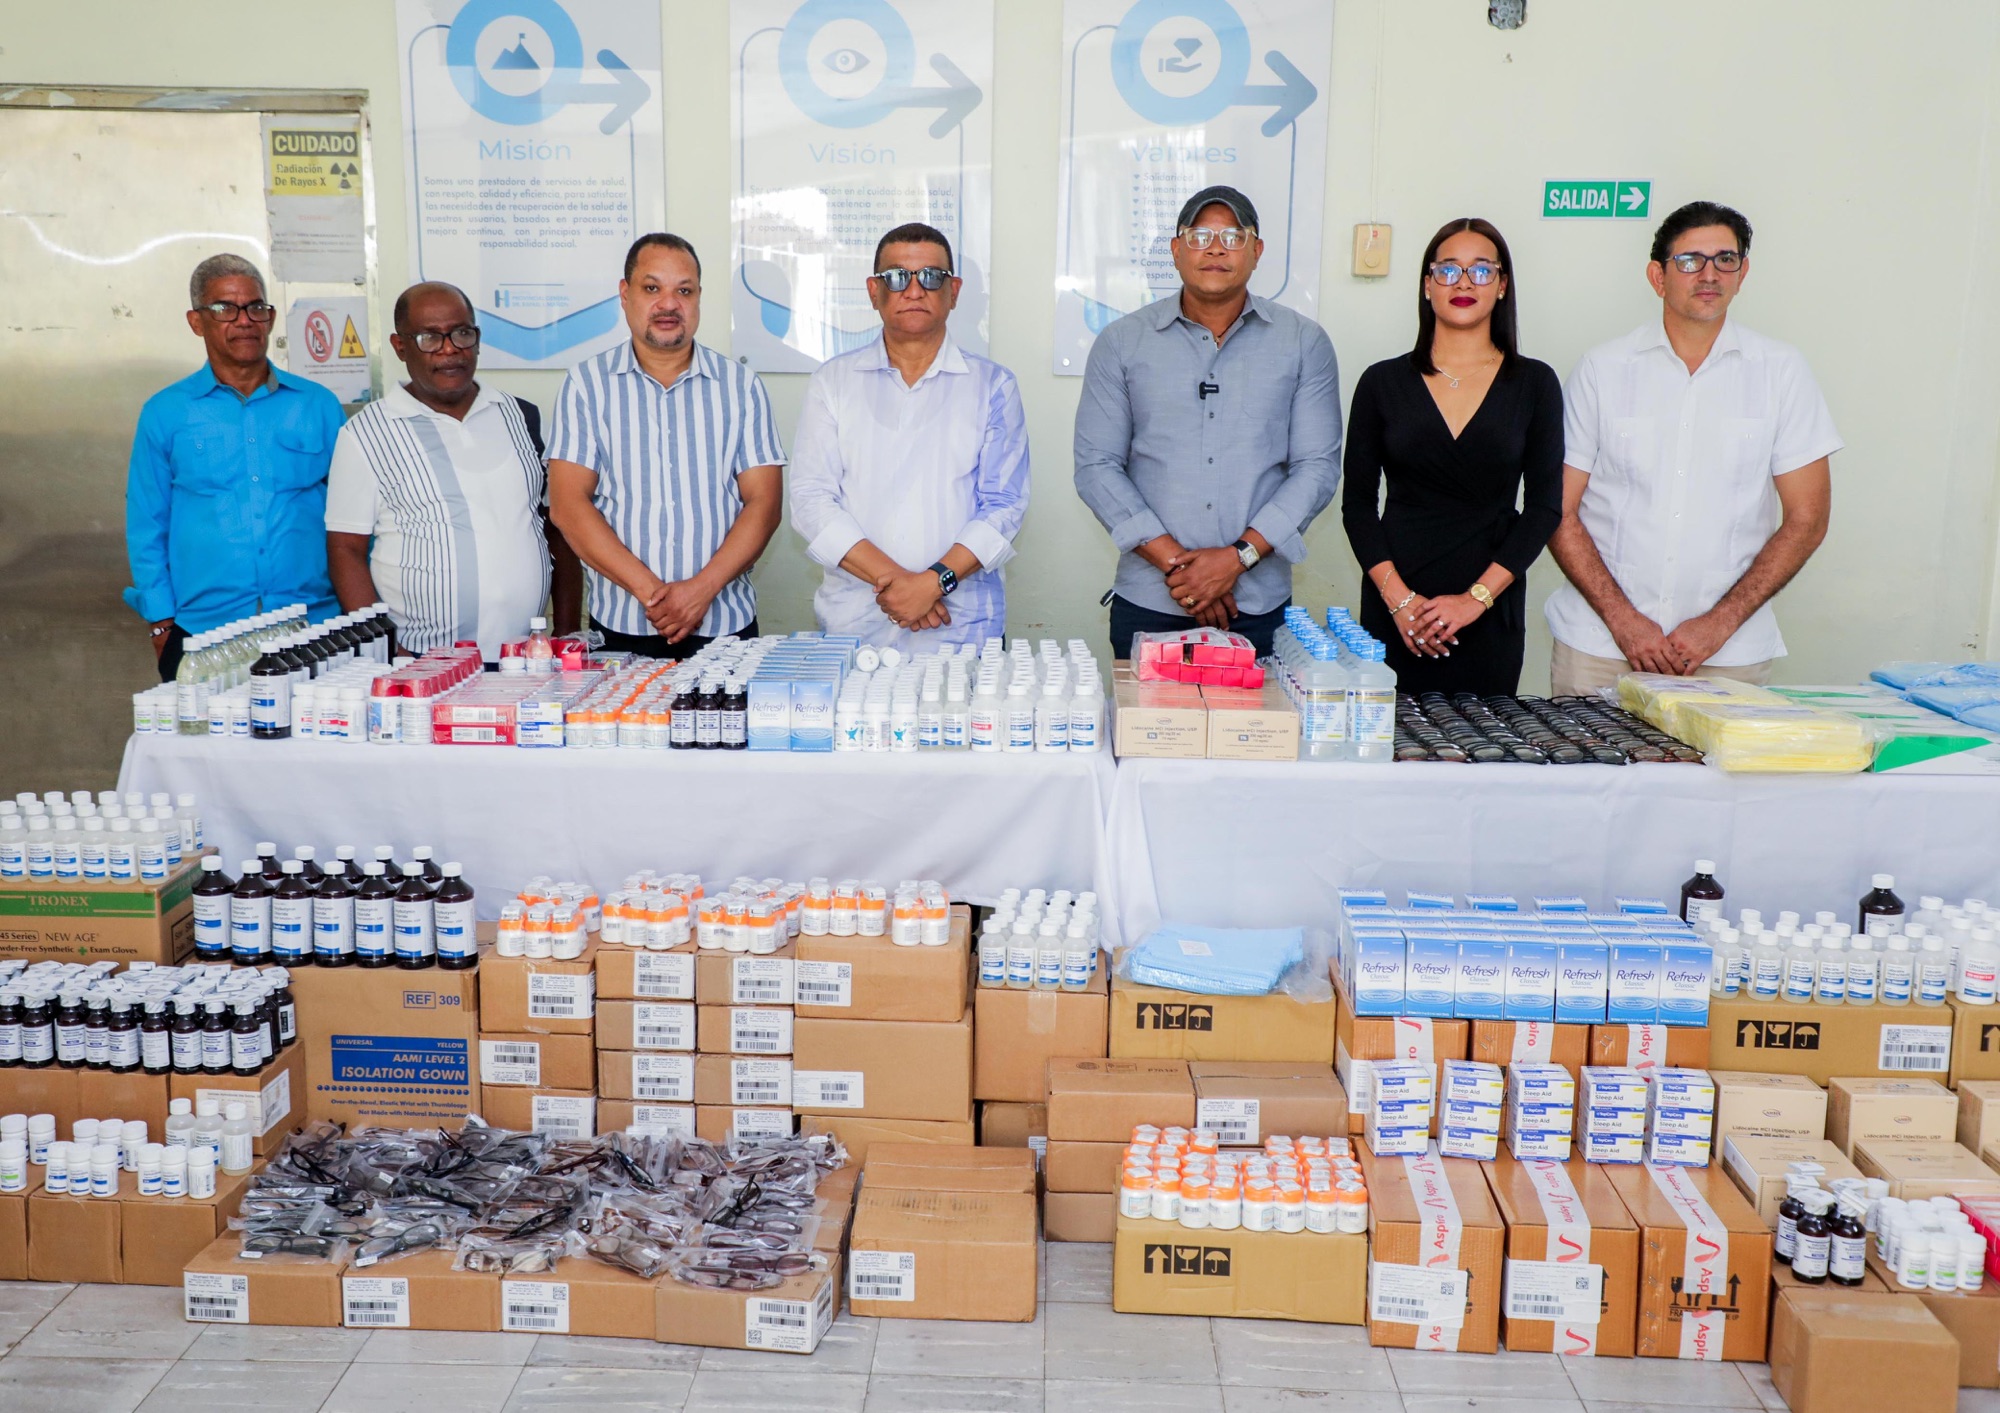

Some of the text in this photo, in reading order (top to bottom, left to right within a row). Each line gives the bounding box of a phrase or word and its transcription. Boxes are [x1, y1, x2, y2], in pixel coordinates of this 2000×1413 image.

[274, 134, 356, 154] CUIDADO
[479, 138, 571, 161] Misión
[808, 142, 896, 164] Visión
[1131, 143, 1237, 163] Valores
[277, 163, 323, 175] Radiación
[275, 176, 327, 188] De Rayos X
[424, 176, 626, 187] Somos una prestadora de servicios de salud,
[1143, 173, 1194, 182] Solidaridad
[425, 189, 627, 201] con respeto, calidad y eficiencia, para satisfacer
[845, 188, 855, 196] en
[857, 186, 865, 196] el
[867, 186, 902, 196] cuidado
[929, 187, 954, 198] salud,
[1549, 188, 1609, 211] SALIDA
[425, 202, 628, 213] las necesidades de recuperación de la salud de
[426, 215, 463, 224] nuestros
[468, 215, 507, 225] usuarios,
[513, 215, 550, 224] basados
[573, 216, 611, 226] procesos
[617, 215, 628, 224] de
[860, 212, 896, 223] integral,
[427, 227, 629, 239] mejora continua, con principios éticos y
[868, 227, 878, 235] en
[479, 240, 577, 251] responsabilidad social.
[1140, 258, 1175, 269] Compro
[752, 702, 786, 713] Refresh
[794, 703, 829, 714] Refresh
[28, 895, 89, 906] TRONEX
[11, 932, 37, 941] Series
[45, 932, 96, 943] NEW AGE
[0, 945, 37, 953] wder-Free
[39, 946, 74, 955] Synthetic
[111, 946, 138, 954] Gloves
[1362, 962, 1399, 974] Refresh
[1412, 962, 1450, 975] Refresh
[1461, 965, 1499, 977] Refresh
[1511, 966, 1550, 979] Refresh
[1563, 968, 1602, 980] Refresh
[1616, 969, 1654, 981] Refresh
[1666, 971, 1706, 983] Refresh
[406, 993, 460, 1006] REF 309
[1528, 1021, 1540, 1047] piro
[336, 1038, 373, 1046] UNIVERSAL
[437, 1041, 464, 1049] YELLOW
[1638, 1024, 1653, 1056] Aspir
[393, 1053, 466, 1065] AAMI LEVEL 2
[341, 1065, 466, 1081] ISOLATION GOWN
[1451, 1087, 1468, 1095] Sleep
[1524, 1090, 1540, 1098] Sleep
[1595, 1094, 1611, 1102] Sleep
[1662, 1094, 1679, 1102] Sleep
[431, 1101, 468, 1109] Thumbloops
[1449, 1113, 1465, 1121] Sleep
[1522, 1117, 1538, 1125] Sleep
[1660, 1121, 1676, 1129] Sleep
[1520, 1143, 1537, 1151] Sleep
[1657, 1147, 1674, 1155] Sleep
[1559, 1204, 1575, 1223] Aspiro
[1433, 1213, 1450, 1249] Aspiro
